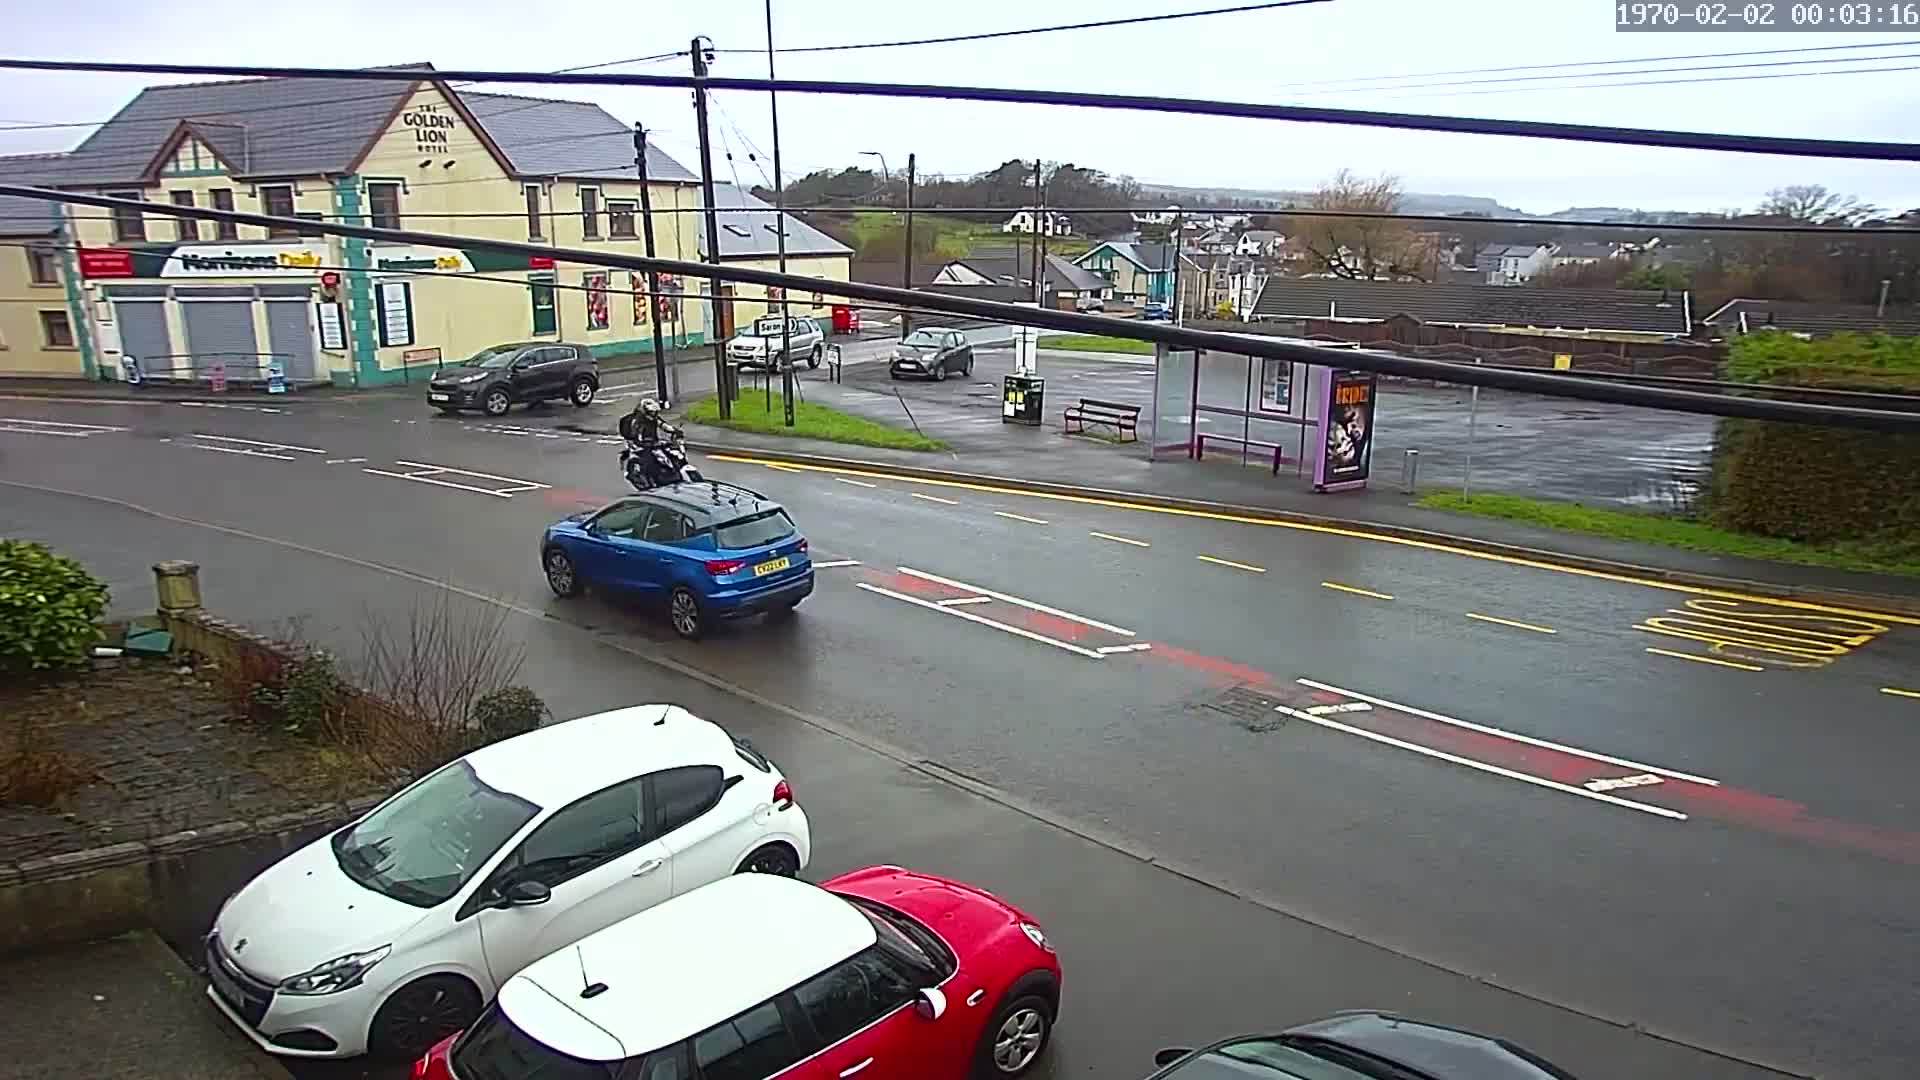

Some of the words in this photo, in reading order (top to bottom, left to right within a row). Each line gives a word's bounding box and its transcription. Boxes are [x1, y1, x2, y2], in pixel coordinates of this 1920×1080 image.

[404, 112, 455, 129] GOLDEN
[416, 128, 448, 143] LION
[418, 144, 449, 154] HOTEL
